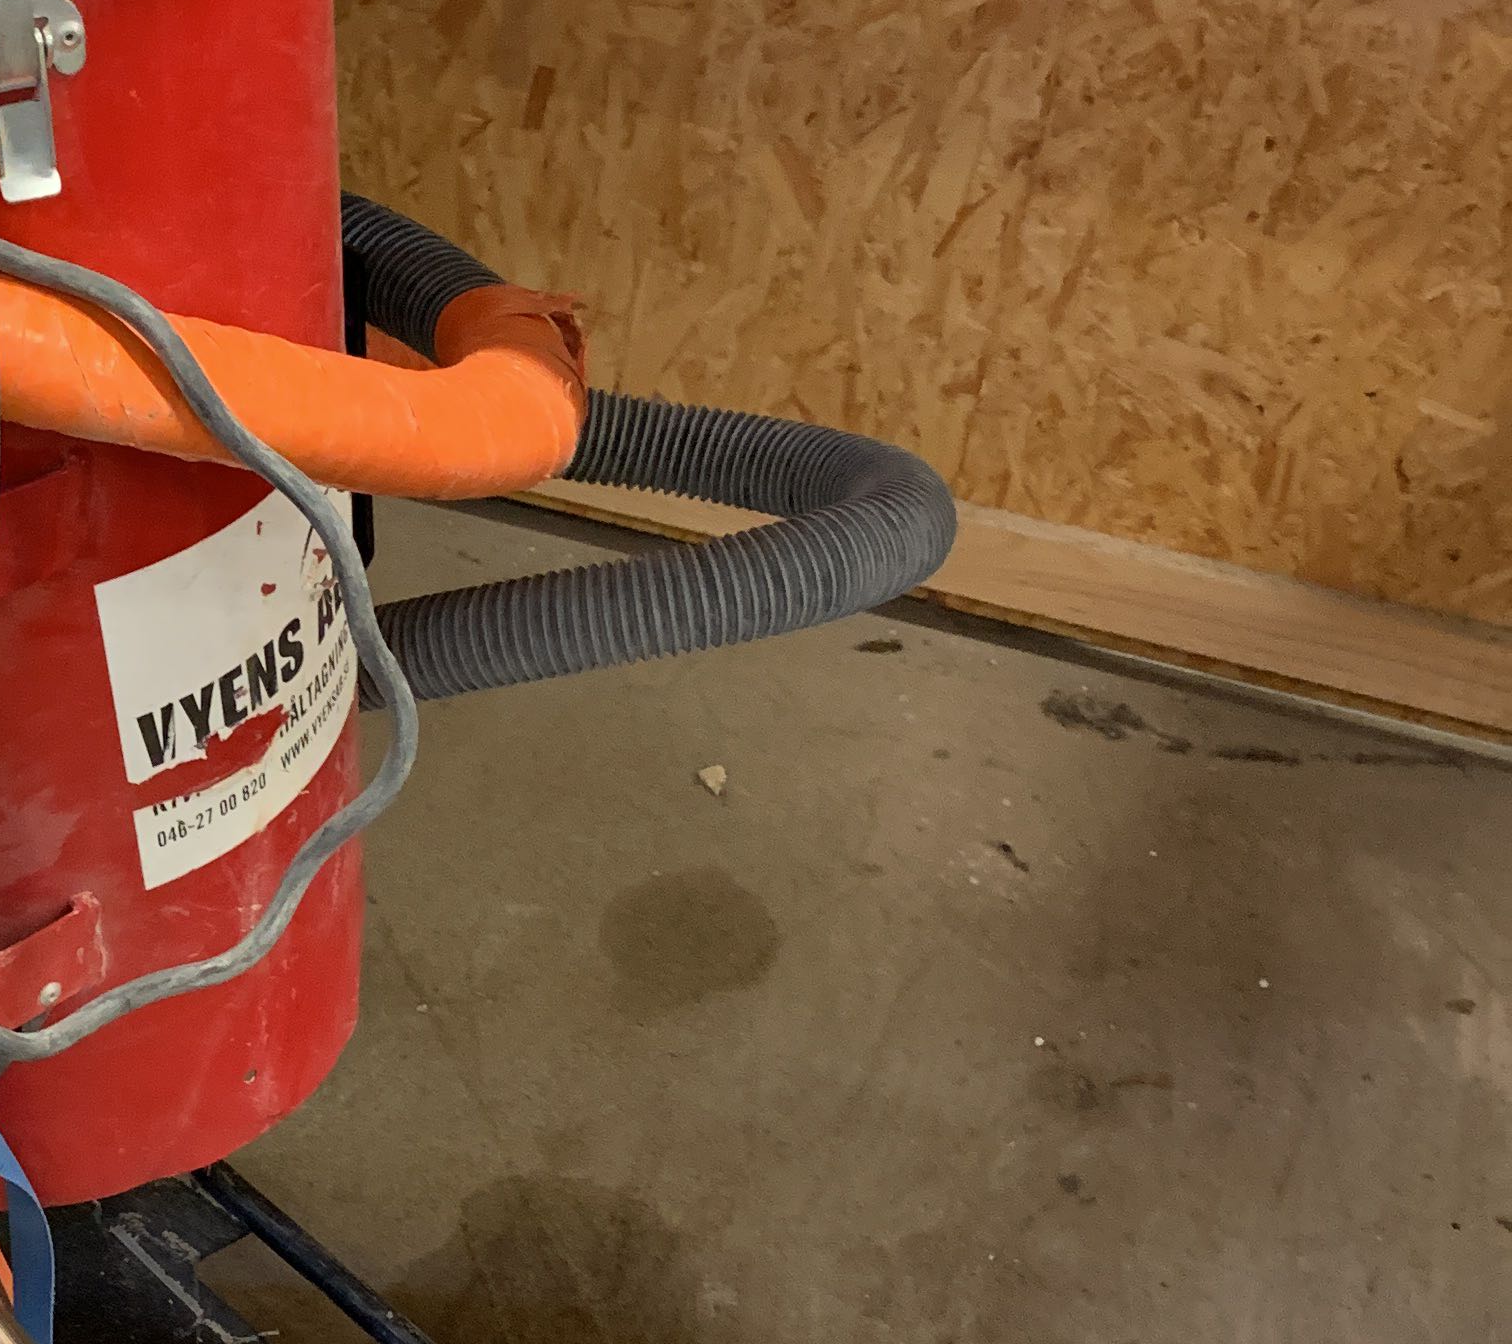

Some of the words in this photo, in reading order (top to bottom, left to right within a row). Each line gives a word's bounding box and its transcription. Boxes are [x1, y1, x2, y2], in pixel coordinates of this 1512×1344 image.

[136, 617, 304, 768] VYENS
[156, 807, 213, 848] 046-27
[219, 793, 237, 816] 00
[241, 772, 267, 802] 820
